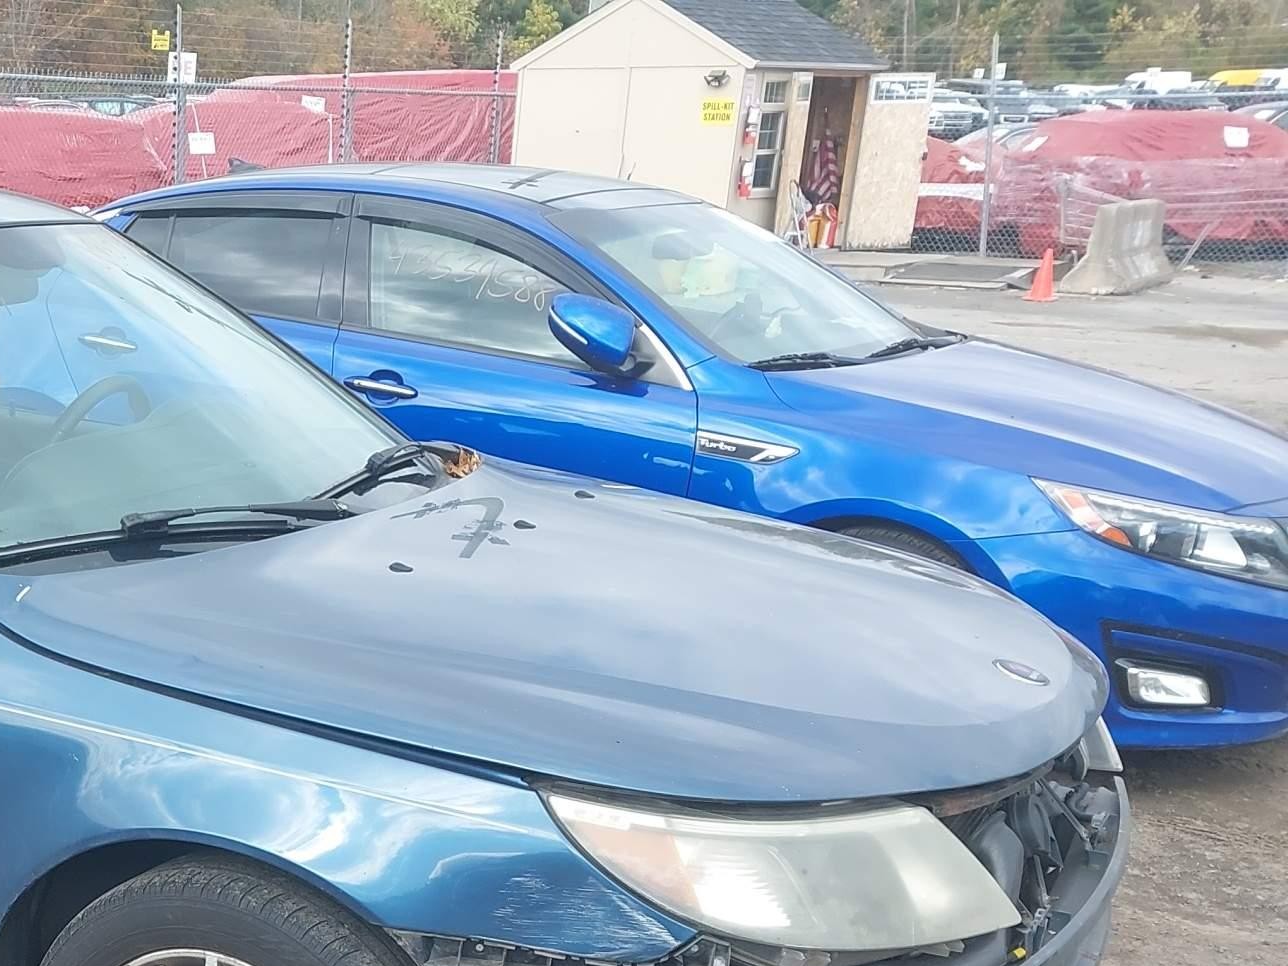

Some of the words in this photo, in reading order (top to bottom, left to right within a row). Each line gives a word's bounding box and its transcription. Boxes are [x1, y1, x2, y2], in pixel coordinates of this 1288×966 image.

[702, 101, 736, 111] SPILL-KIT
[703, 112, 731, 121] STATION
[699, 438, 737, 453] Turbo
